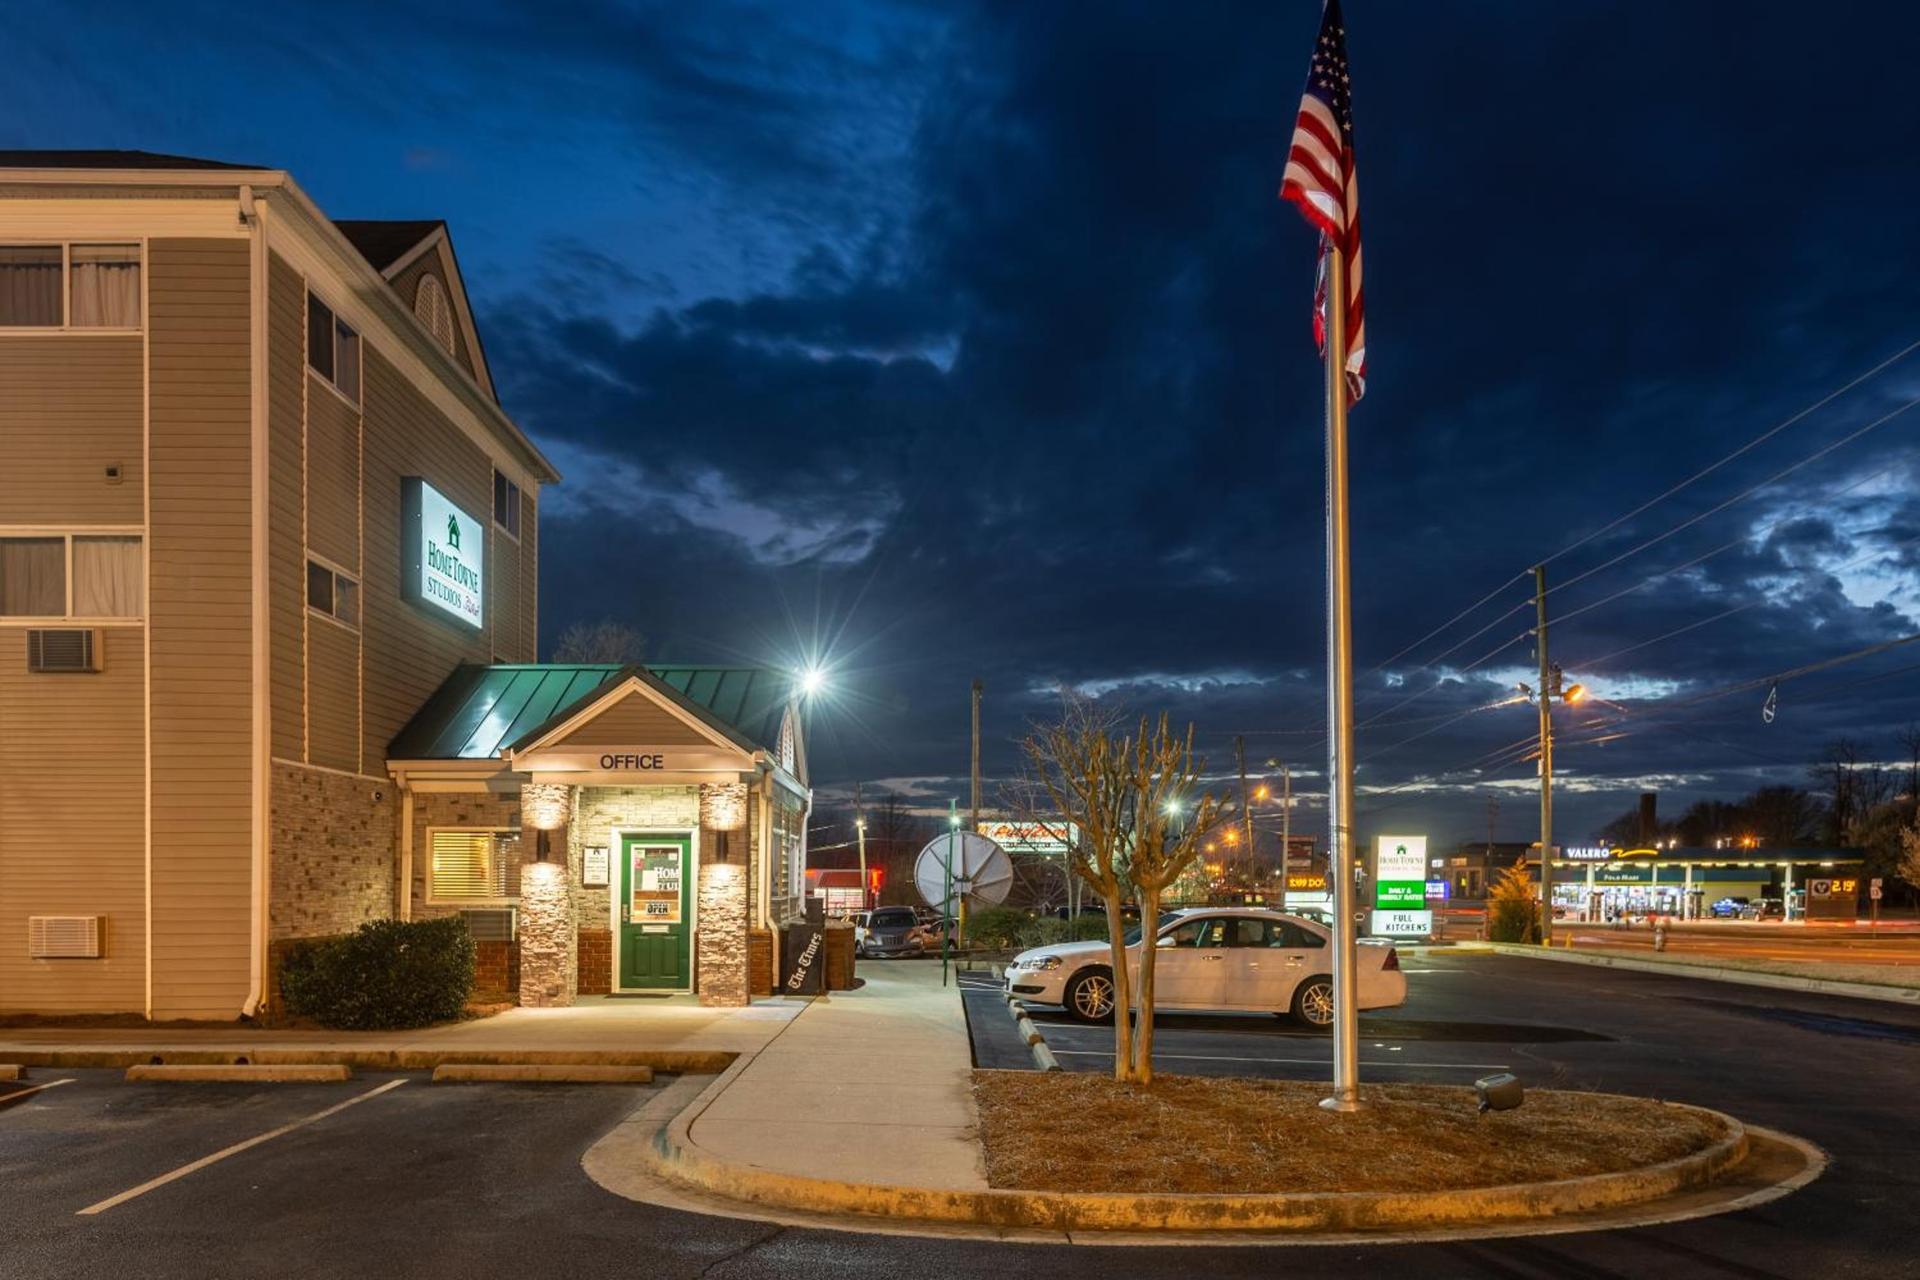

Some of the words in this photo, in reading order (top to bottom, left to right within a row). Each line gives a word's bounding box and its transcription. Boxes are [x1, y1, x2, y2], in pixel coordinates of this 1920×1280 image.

[428, 576, 462, 609] STUDIOS
[600, 755, 664, 769] OFFICE
[1567, 848, 1610, 858] VALERO
[647, 904, 668, 913] OPEN
[788, 967, 806, 989] The
[798, 932, 822, 966] Times
